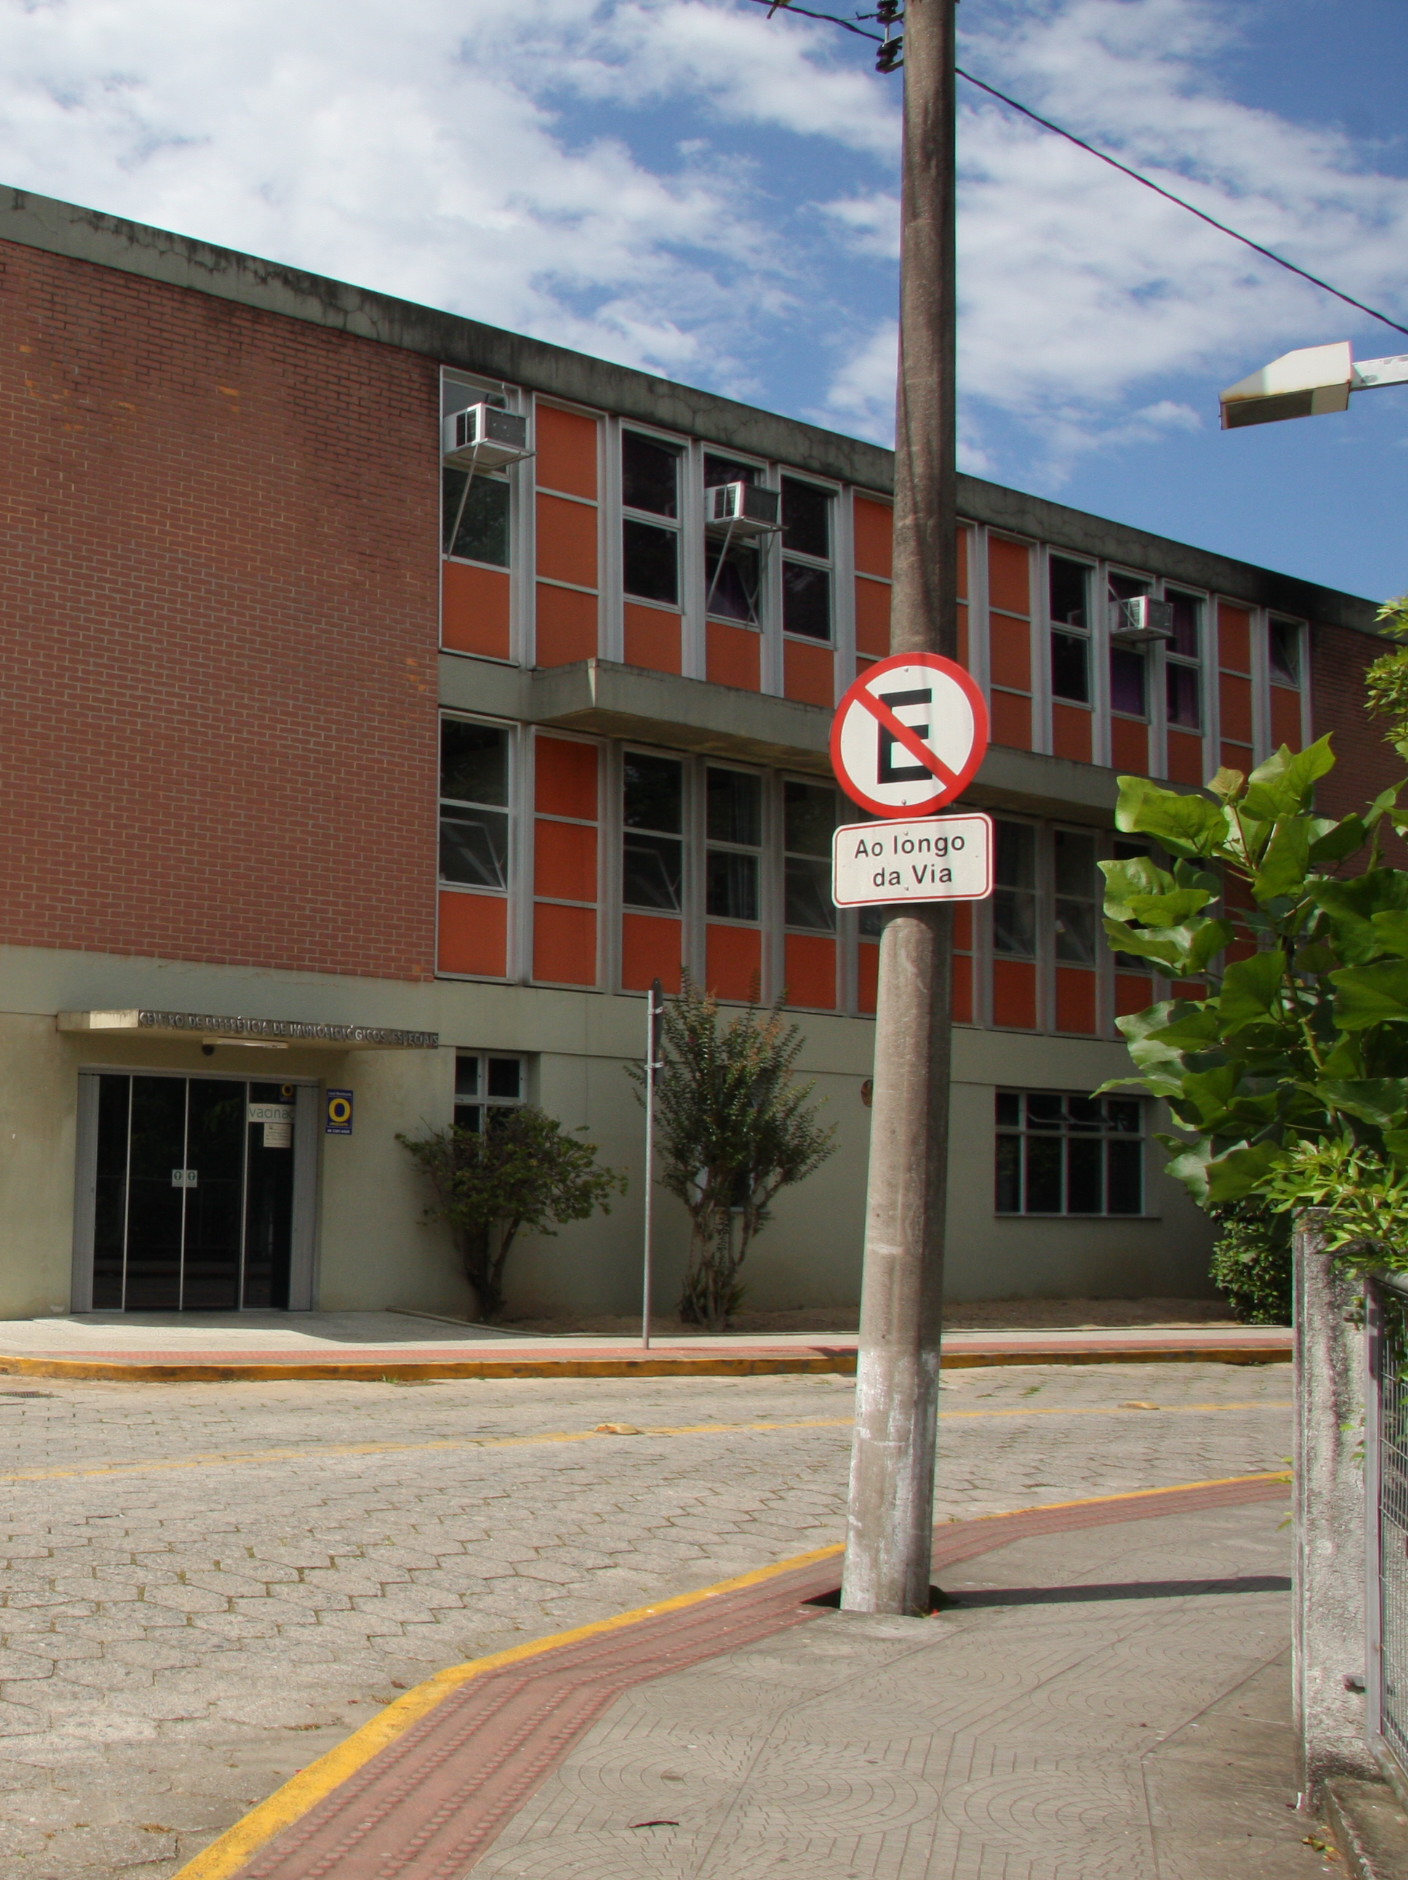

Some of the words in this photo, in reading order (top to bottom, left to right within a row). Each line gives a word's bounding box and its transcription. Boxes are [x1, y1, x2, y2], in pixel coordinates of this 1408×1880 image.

[877, 688, 933, 785] E
[854, 838, 883, 859] Ao
[894, 834, 965, 857] longo
[872, 867, 901, 887] da
[912, 864, 952, 885] Via
